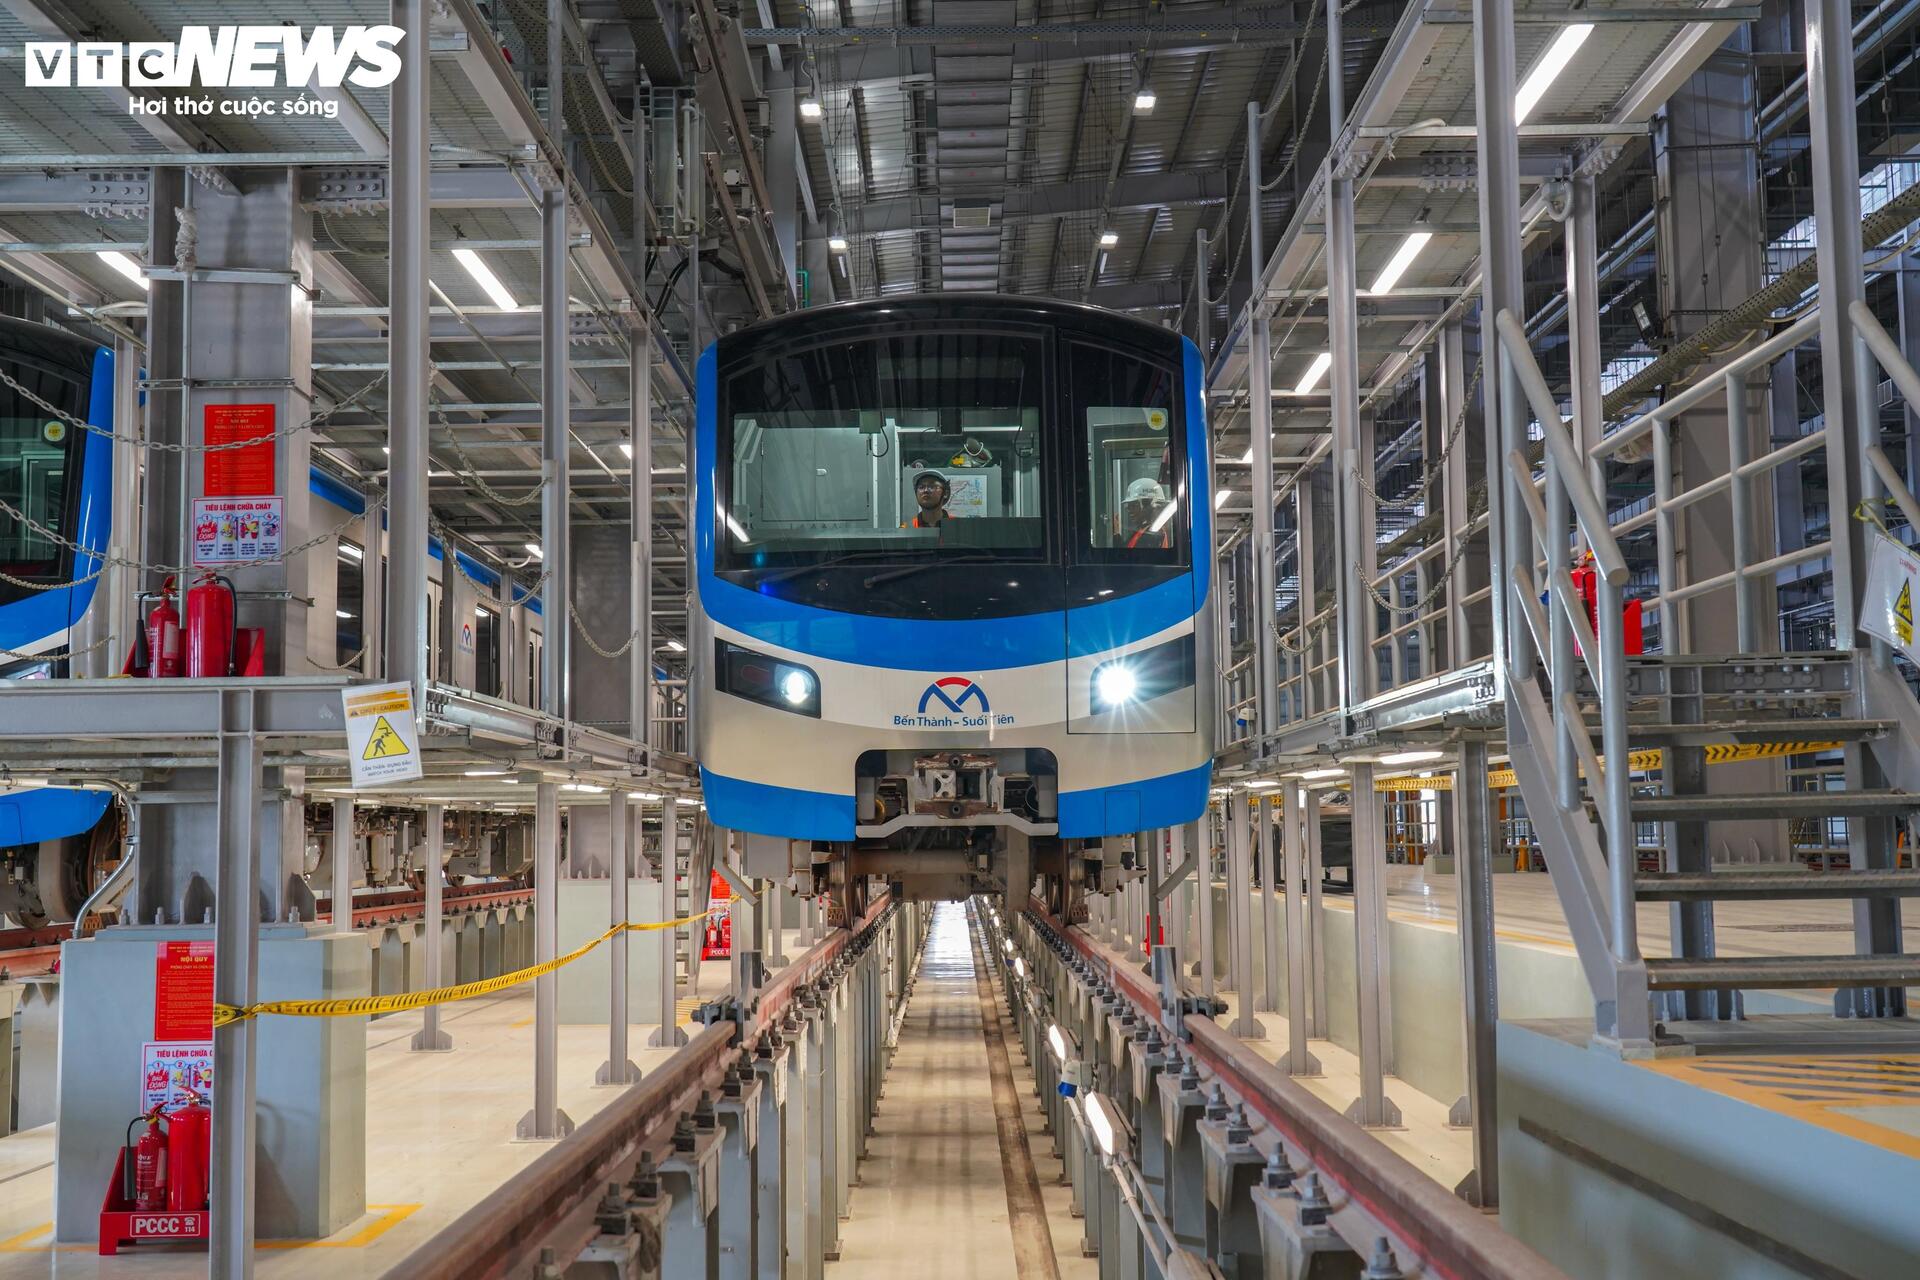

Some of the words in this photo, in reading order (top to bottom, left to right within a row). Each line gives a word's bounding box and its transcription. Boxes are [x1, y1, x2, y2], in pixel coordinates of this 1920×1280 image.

[893, 714, 915, 726] Bến
[917, 716, 952, 727] Thành
[963, 714, 987, 726] Suối
[135, 1217, 180, 1233] PCCC
